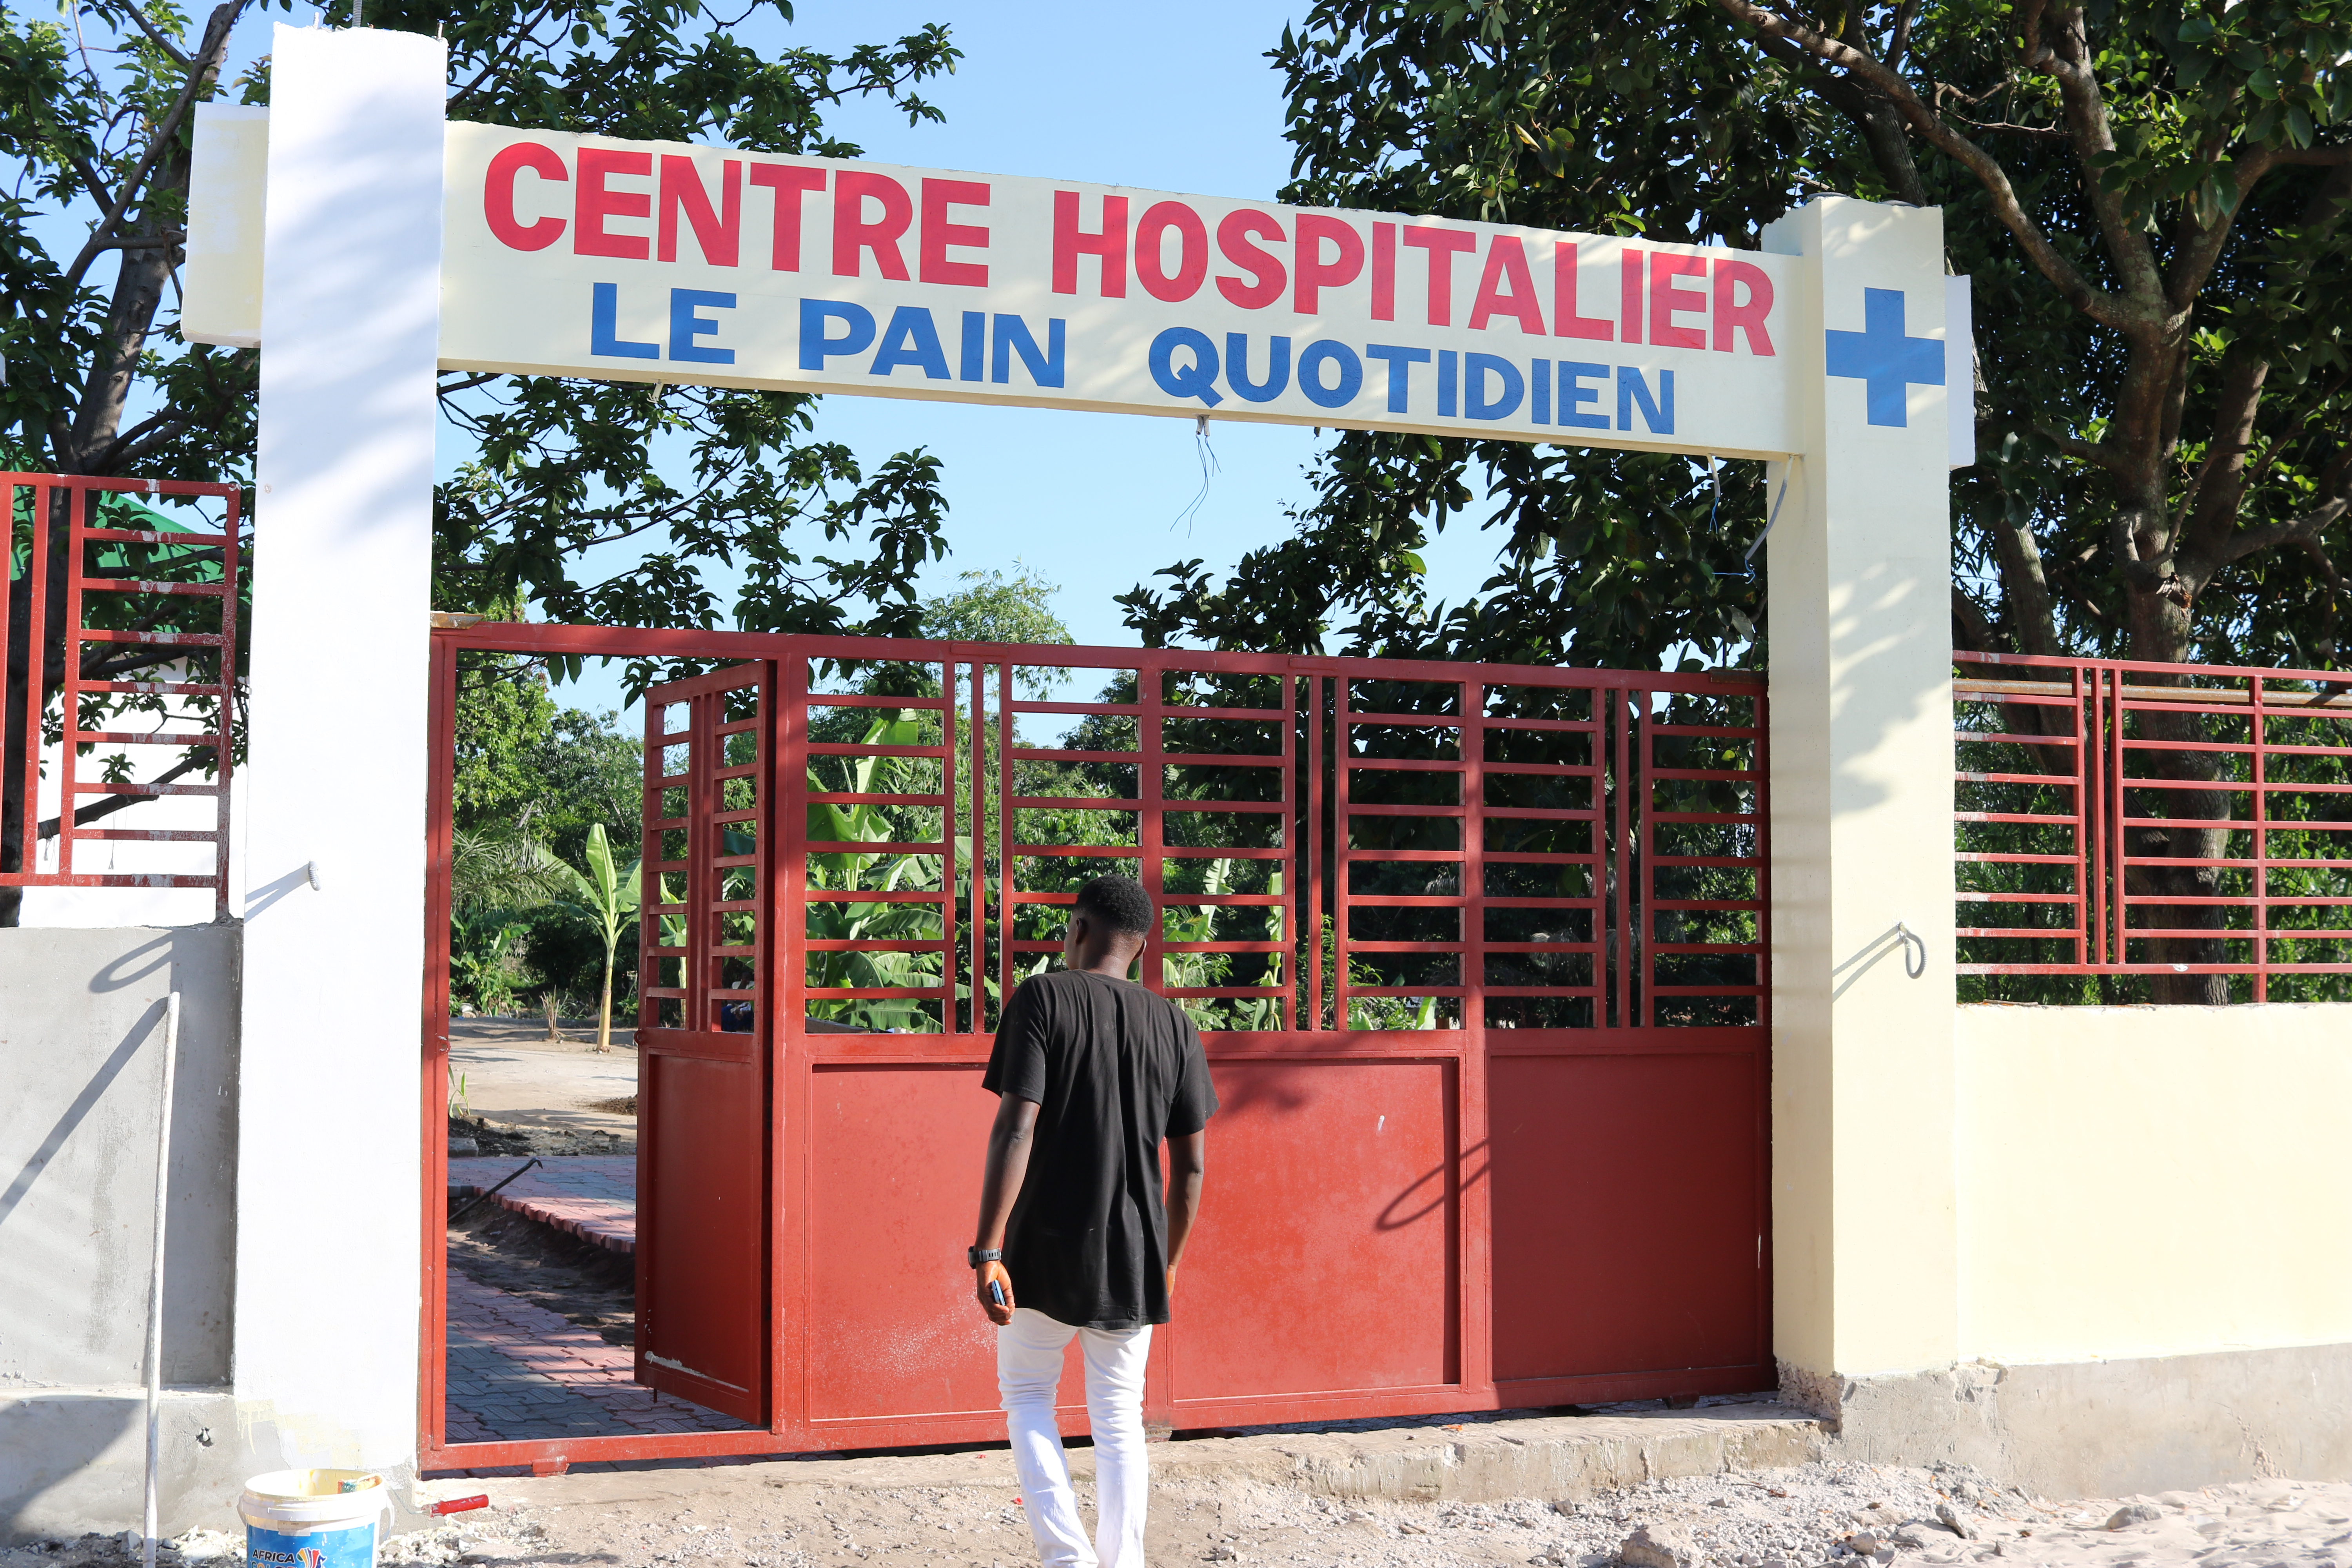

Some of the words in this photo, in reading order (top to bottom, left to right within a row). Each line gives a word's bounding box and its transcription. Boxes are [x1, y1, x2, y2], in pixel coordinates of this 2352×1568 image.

[485, 142, 990, 287] CENTRE
[1053, 190, 1776, 356] HOSPITALIER
[592, 283, 737, 364] LE
[799, 298, 1065, 388] PAIN
[1149, 327, 1674, 435] QUOTIDIEN
[252, 1548, 295, 1563] AFRICA
